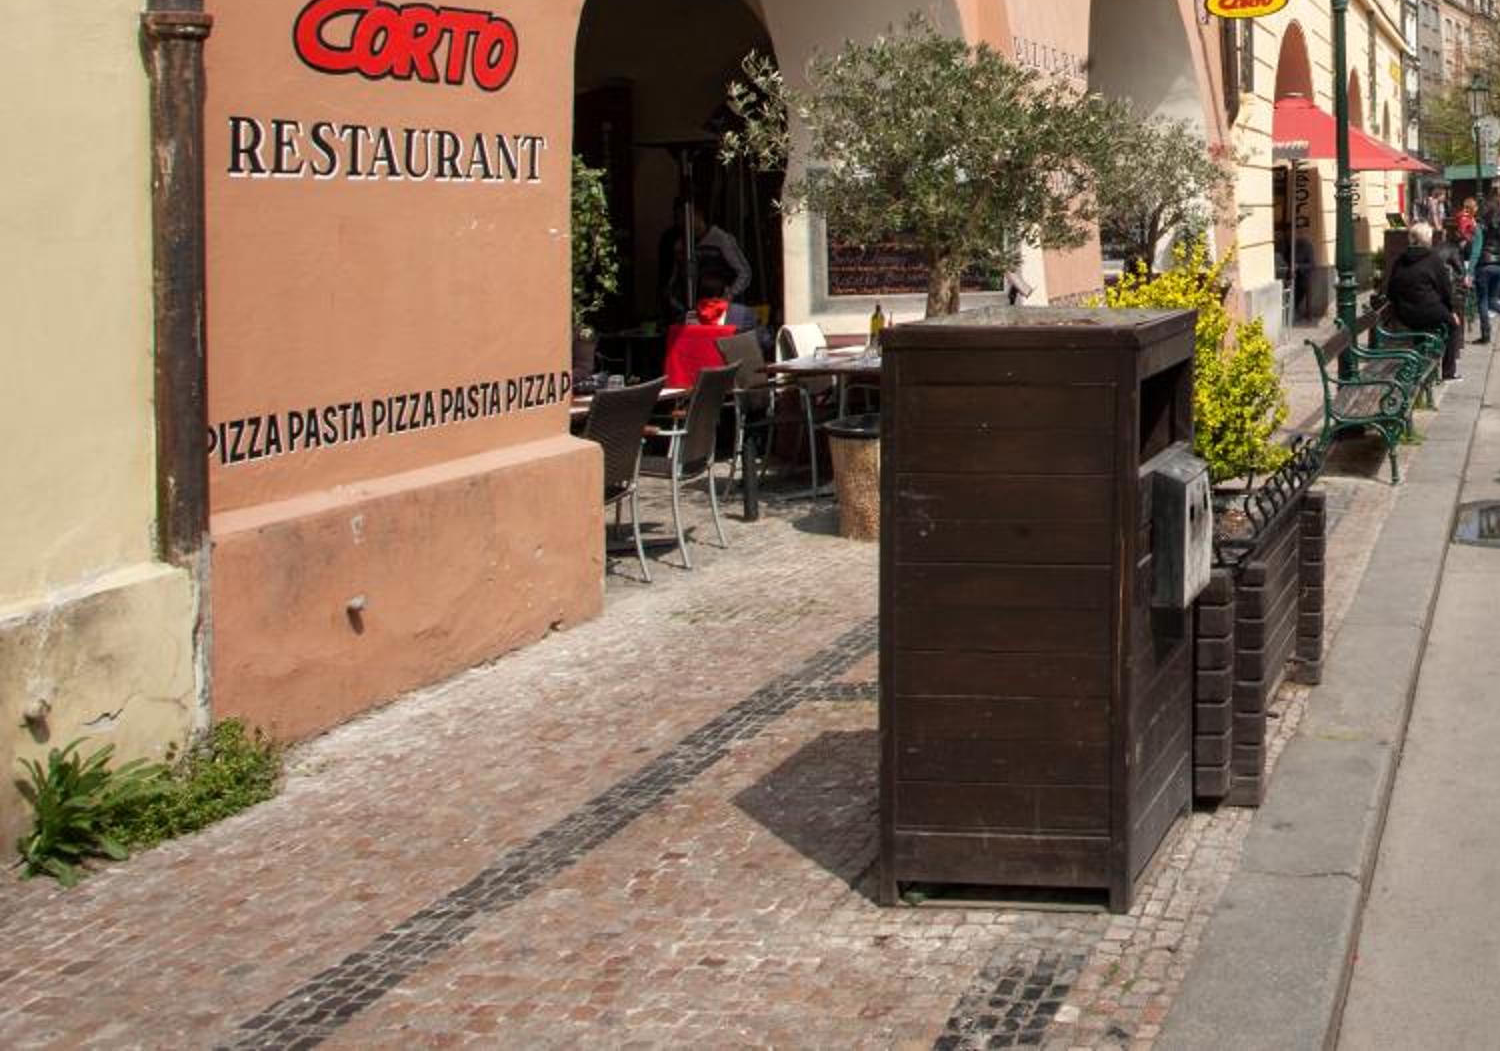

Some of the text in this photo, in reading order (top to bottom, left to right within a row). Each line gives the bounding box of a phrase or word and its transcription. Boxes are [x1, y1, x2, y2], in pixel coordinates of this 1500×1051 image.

[227, 116, 545, 184] RESTAURANT
[288, 400, 367, 456] PASTA
[371, 391, 437, 437] PIZZA
[440, 380, 502, 426] PASTA
[505, 373, 558, 412] PIZZA
